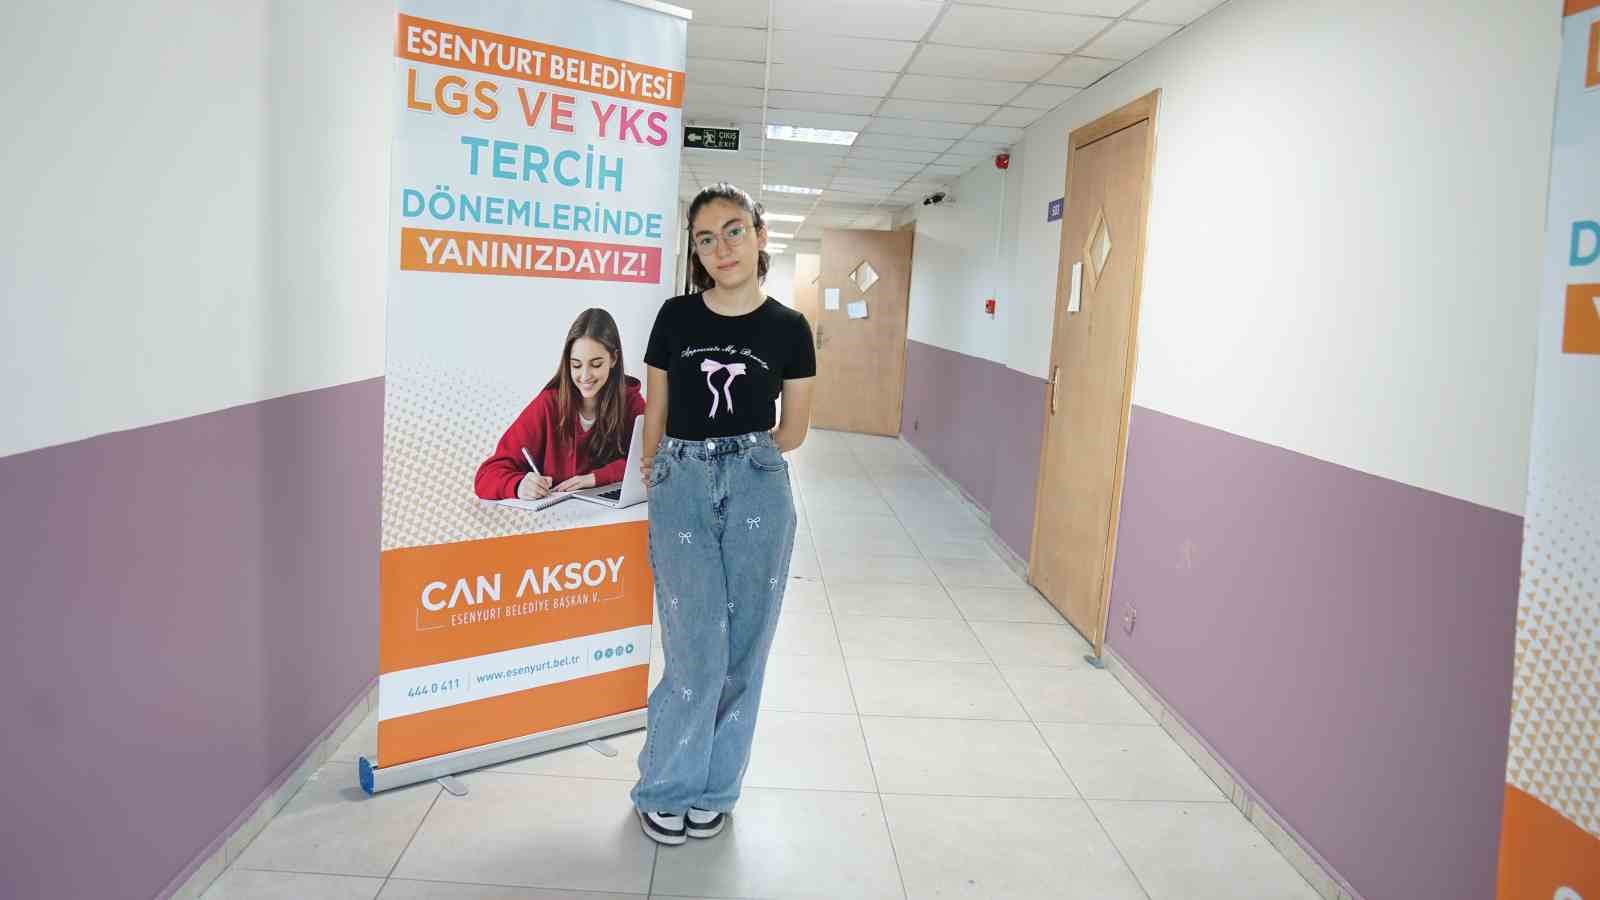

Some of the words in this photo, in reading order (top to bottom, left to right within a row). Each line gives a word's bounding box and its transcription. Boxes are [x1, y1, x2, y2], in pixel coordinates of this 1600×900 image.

[407, 25, 545, 76] ESENYURT
[550, 55, 673, 100] BELEDİYESİ
[407, 68, 499, 120] LGS
[516, 87, 576, 133] VE
[592, 100, 668, 147] YKS
[460, 136, 623, 192] TERCİH
[402, 185, 662, 238] DÖNEMLERİNDE
[418, 236, 648, 277] YANINIZDAYIZ!
[421, 573, 501, 611] CAN
[516, 556, 624, 597] AKSOY
[451, 607, 501, 626] ESENYURT
[505, 600, 549, 617] BELEDİYE
[553, 594, 588, 610] BAŞKAN
[407, 682, 428, 697] 444
[431, 682, 438, 694] 0
[441, 678, 460, 692] 411
[476, 654, 581, 684] www.esenyurt.bel.tr
